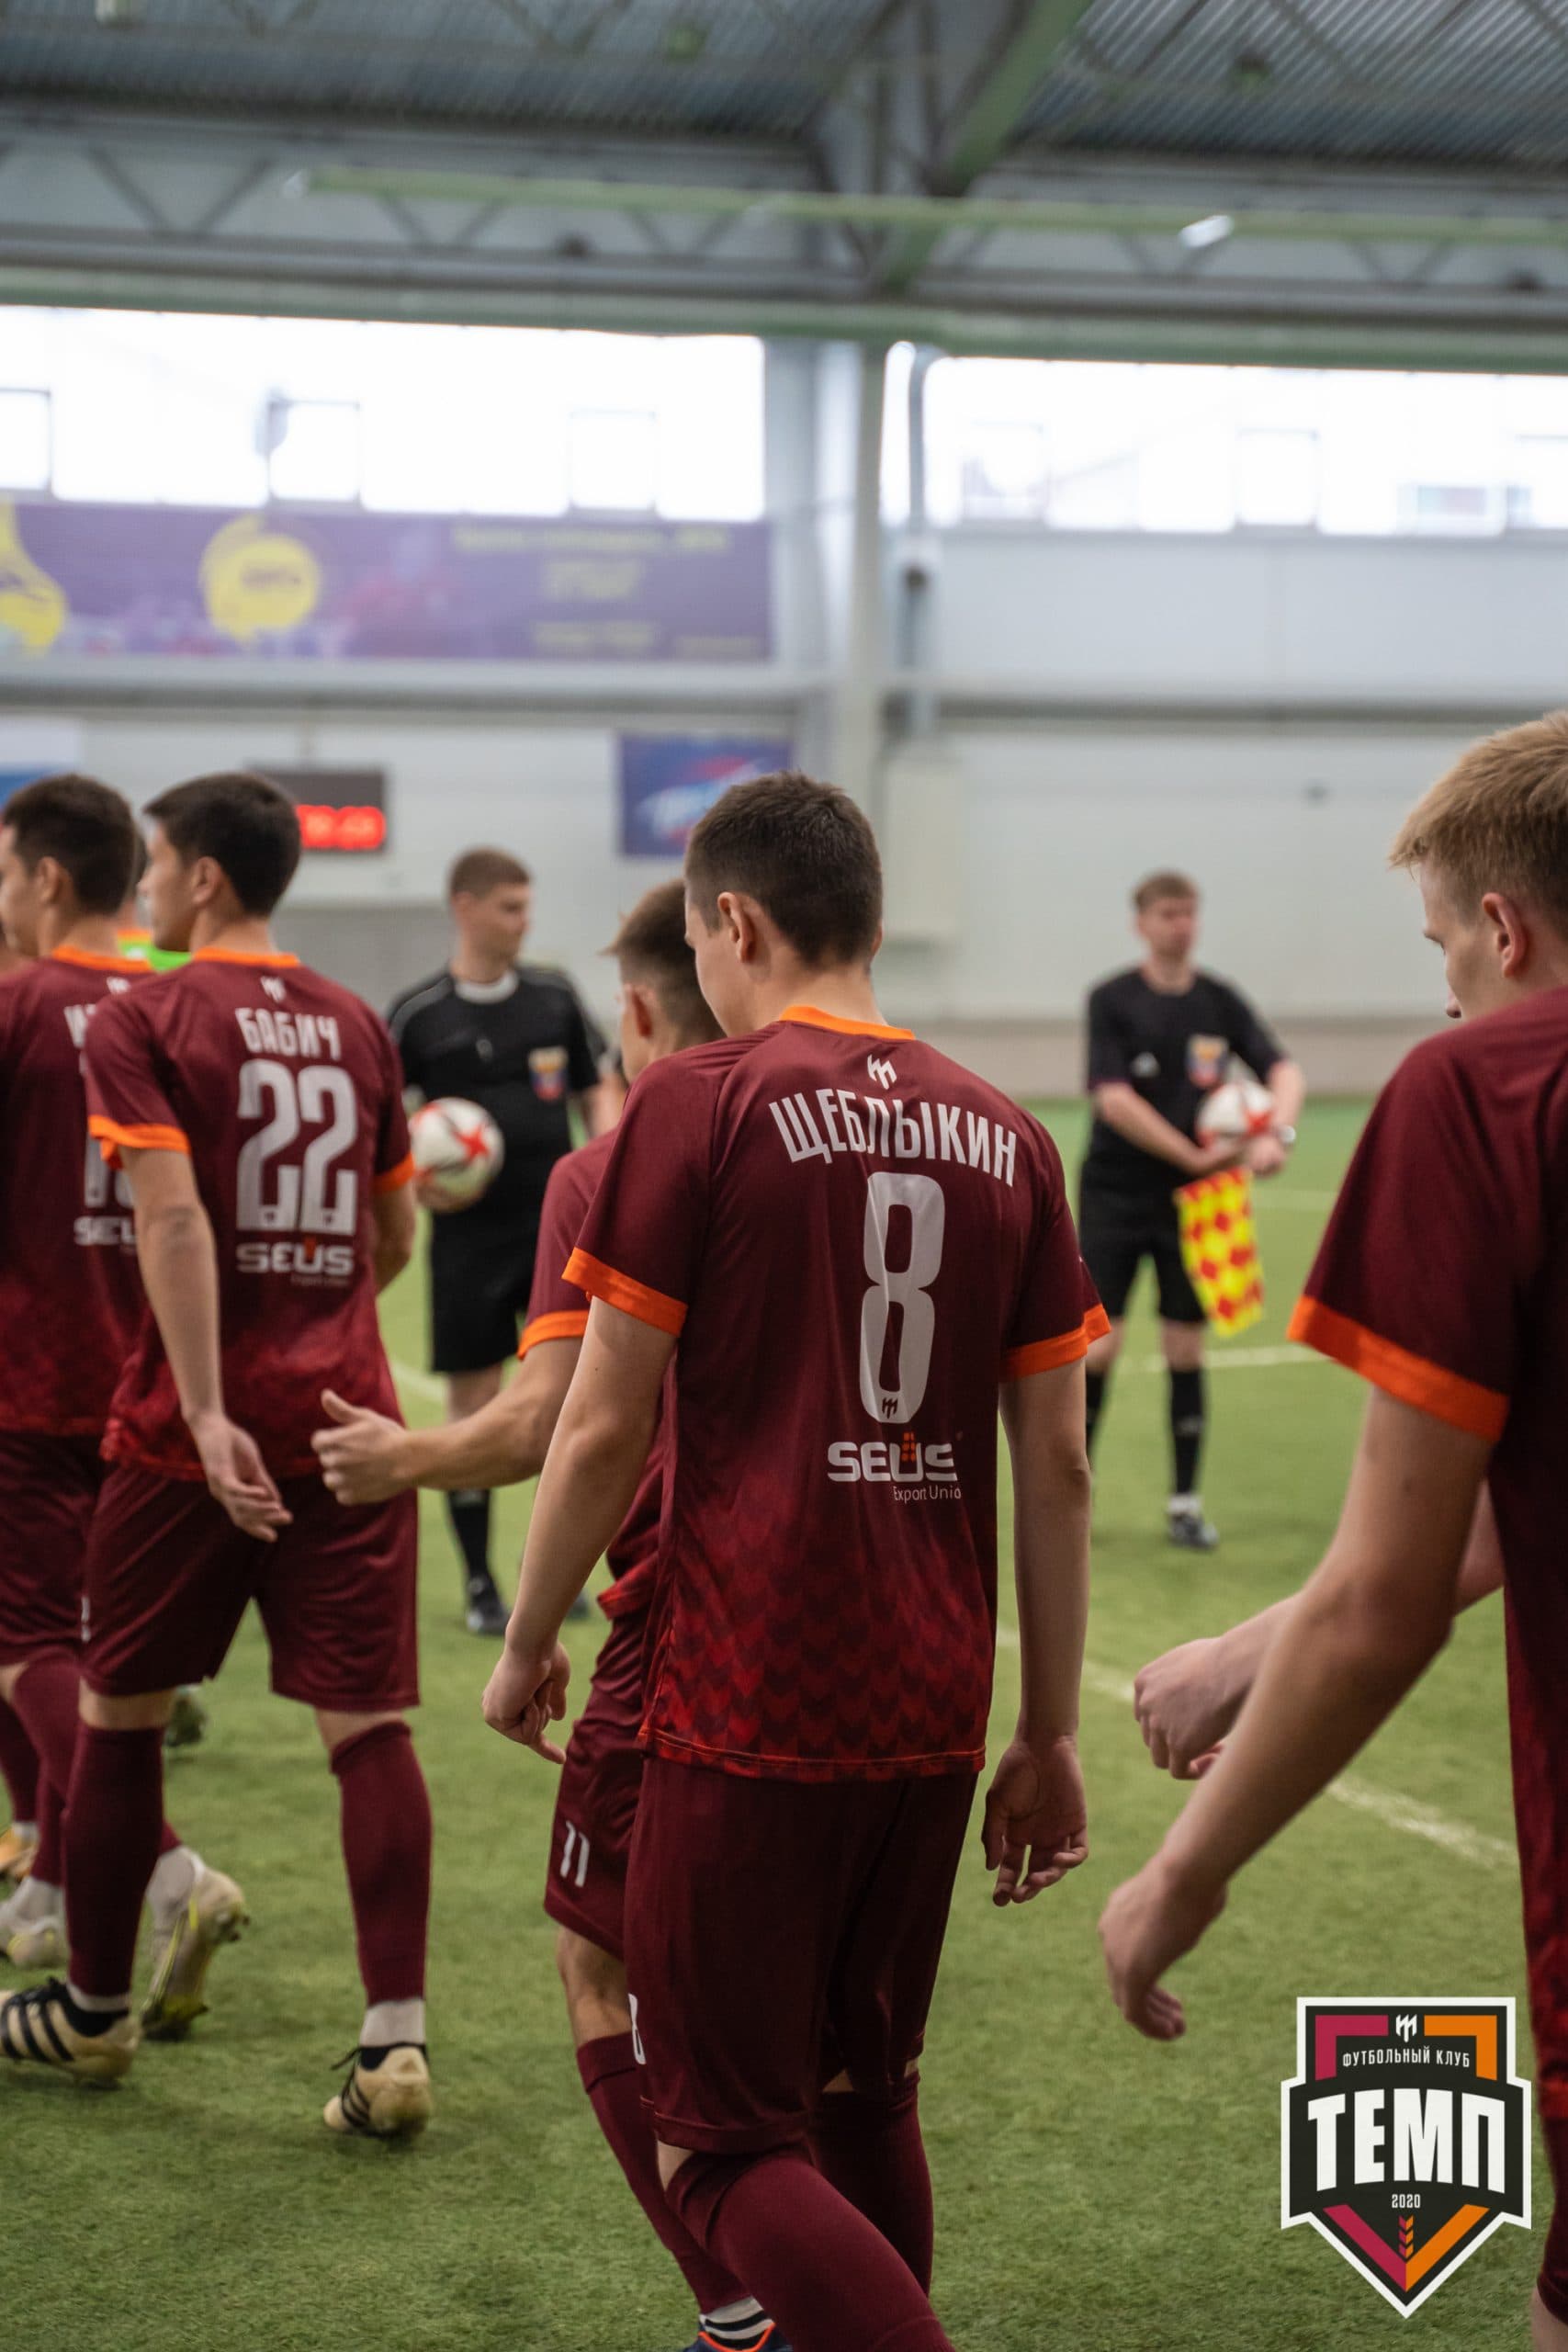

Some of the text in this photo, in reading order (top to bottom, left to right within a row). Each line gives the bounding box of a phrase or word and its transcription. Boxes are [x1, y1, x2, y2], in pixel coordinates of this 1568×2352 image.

[235, 1008, 341, 1061] БАБИЧ
[237, 1059, 357, 1235] 22
[769, 1089, 1017, 1186] ЩЕБЛЫКИН
[73, 1216, 137, 1246] SEU
[237, 1242, 355, 1275] SEUS
[860, 1171, 945, 1423] 8
[828, 1442, 957, 1482] SEUS
[893, 1486, 927, 1503] Export
[559, 1820, 591, 1888] 11
